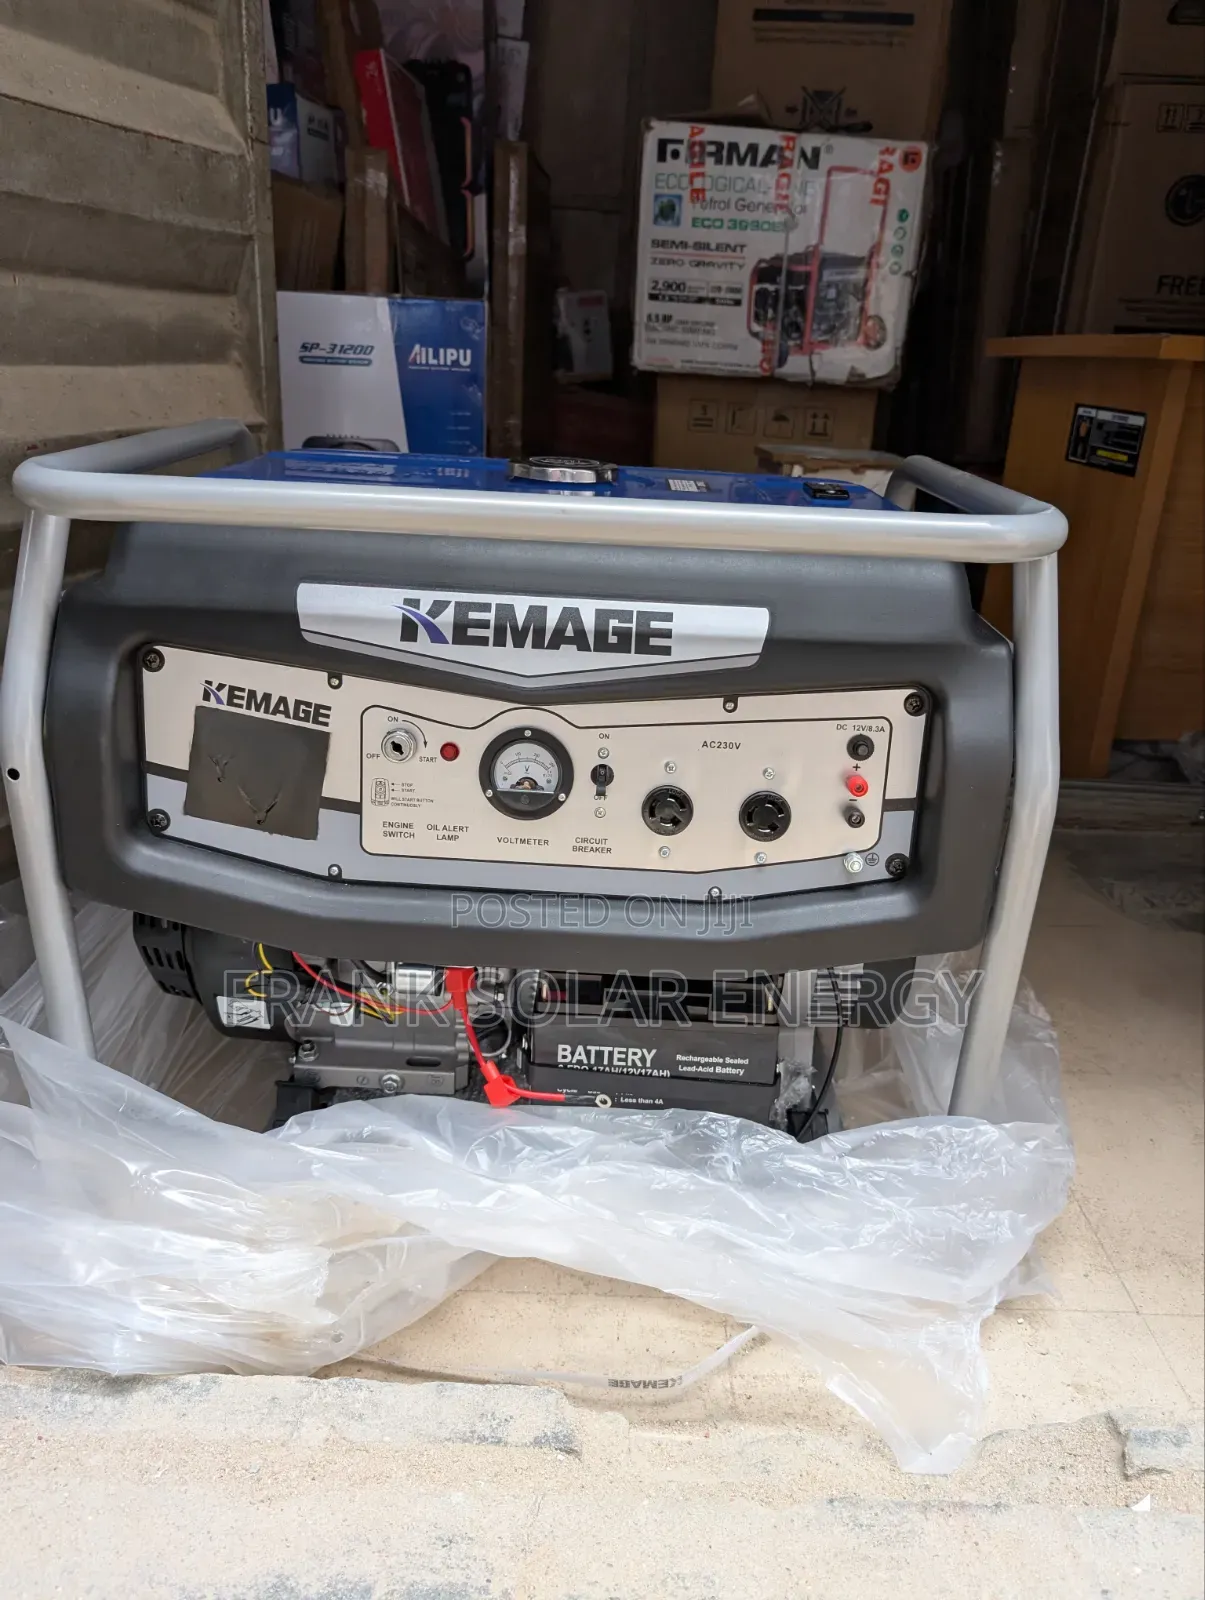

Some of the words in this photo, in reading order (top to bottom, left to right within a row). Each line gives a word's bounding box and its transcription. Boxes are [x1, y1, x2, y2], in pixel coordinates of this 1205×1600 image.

[692, 216, 723, 229] ECO
[650, 239, 747, 254] SEMI-SILENT
[689, 259, 745, 271] GRAVITY
[408, 343, 472, 366] AILIPU
[391, 598, 674, 656] KEMAGE
[200, 680, 332, 727] KEMAGE
[387, 715, 399, 723] ON
[836, 723, 848, 731] DC
[852, 724, 886, 733] 12V/8.3A
[701, 740, 741, 751] AC230V
[366, 752, 381, 760] OFF
[382, 821, 414, 829] ENGINE
[426, 824, 440, 832] OIL
[441, 825, 469, 833] ALERT
[382, 830, 415, 839] SWITCH
[436, 833, 460, 841] LAMP
[496, 836, 549, 846] VOLTMETER
[575, 836, 608, 845] CIRCUIT
[572, 845, 612, 854] BREAKER
[557, 1044, 657, 1067] BATTERY
[676, 1054, 723, 1064] Rechargeable
[725, 1056, 749, 1065] Sealed
[678, 1064, 714, 1073] Lead-Acid
[715, 1066, 745, 1075] Battery
